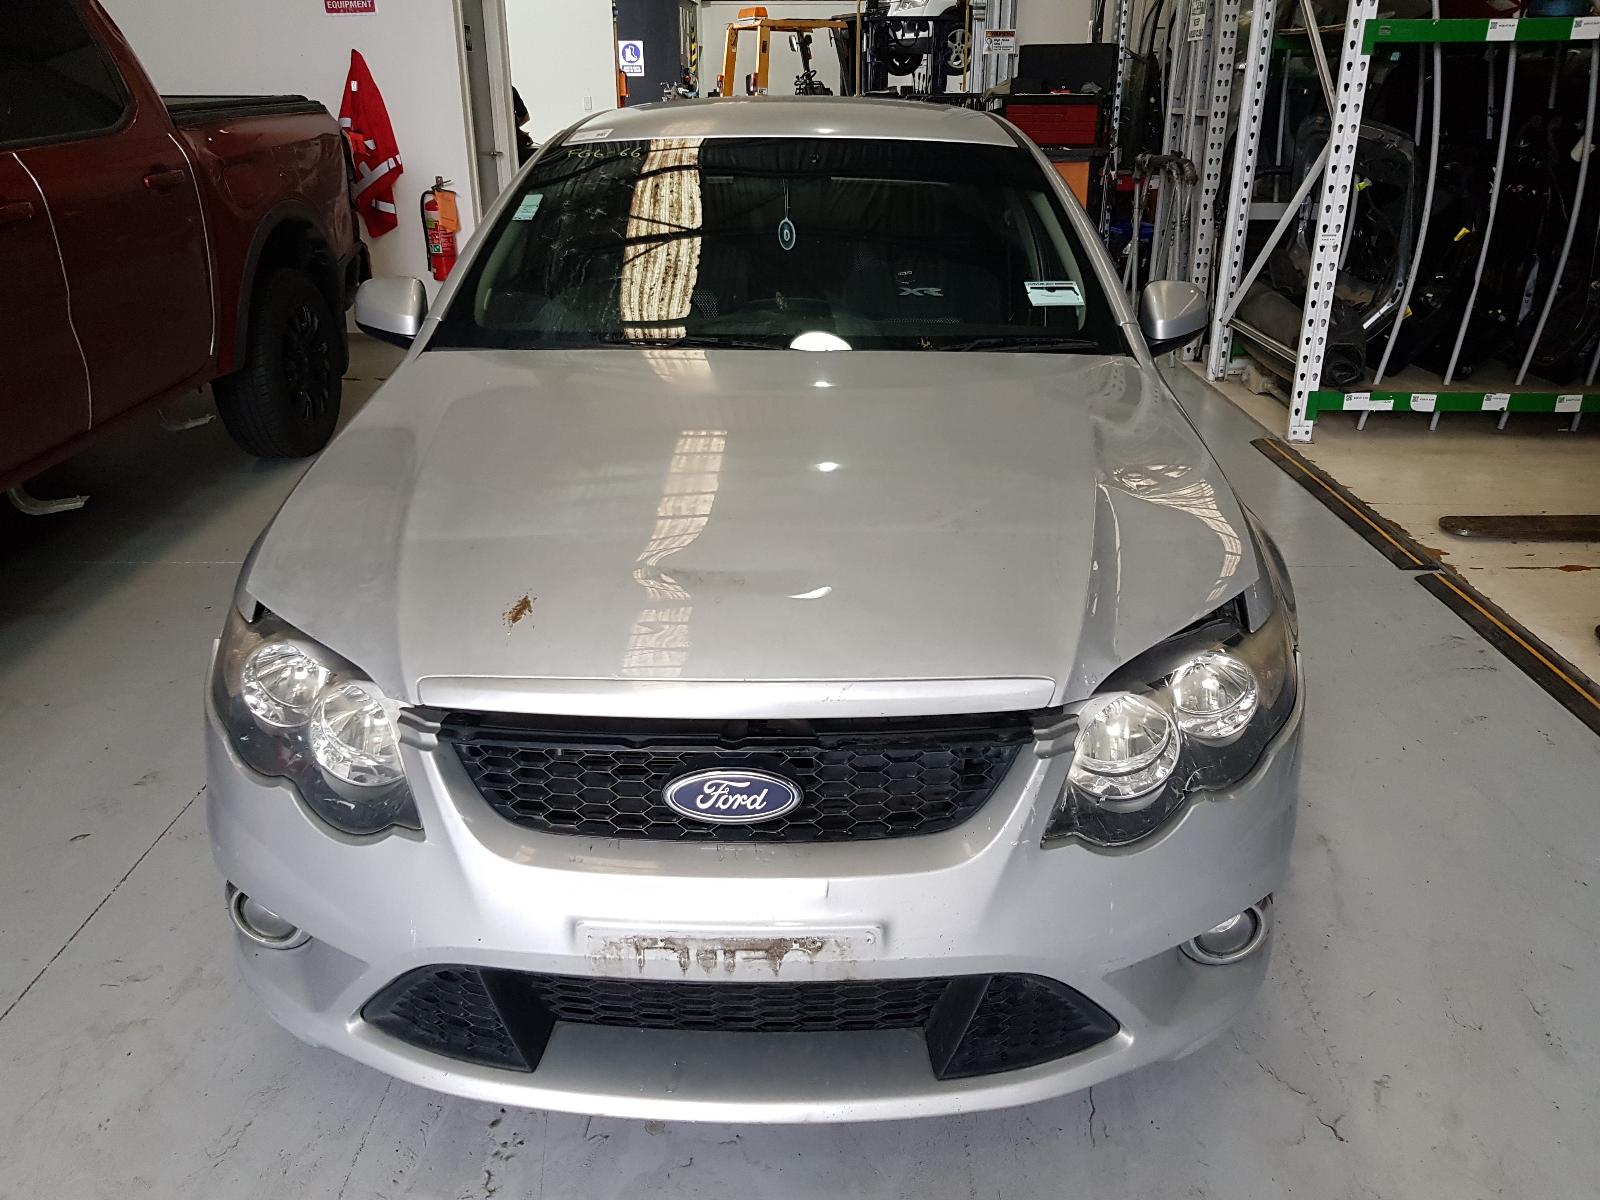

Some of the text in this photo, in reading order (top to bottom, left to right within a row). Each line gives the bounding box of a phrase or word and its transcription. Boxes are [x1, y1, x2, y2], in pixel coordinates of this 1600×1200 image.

[327, 0, 372, 9] EQUIPMENT
[898, 287, 944, 296] XR
[696, 779, 769, 810] Ford
